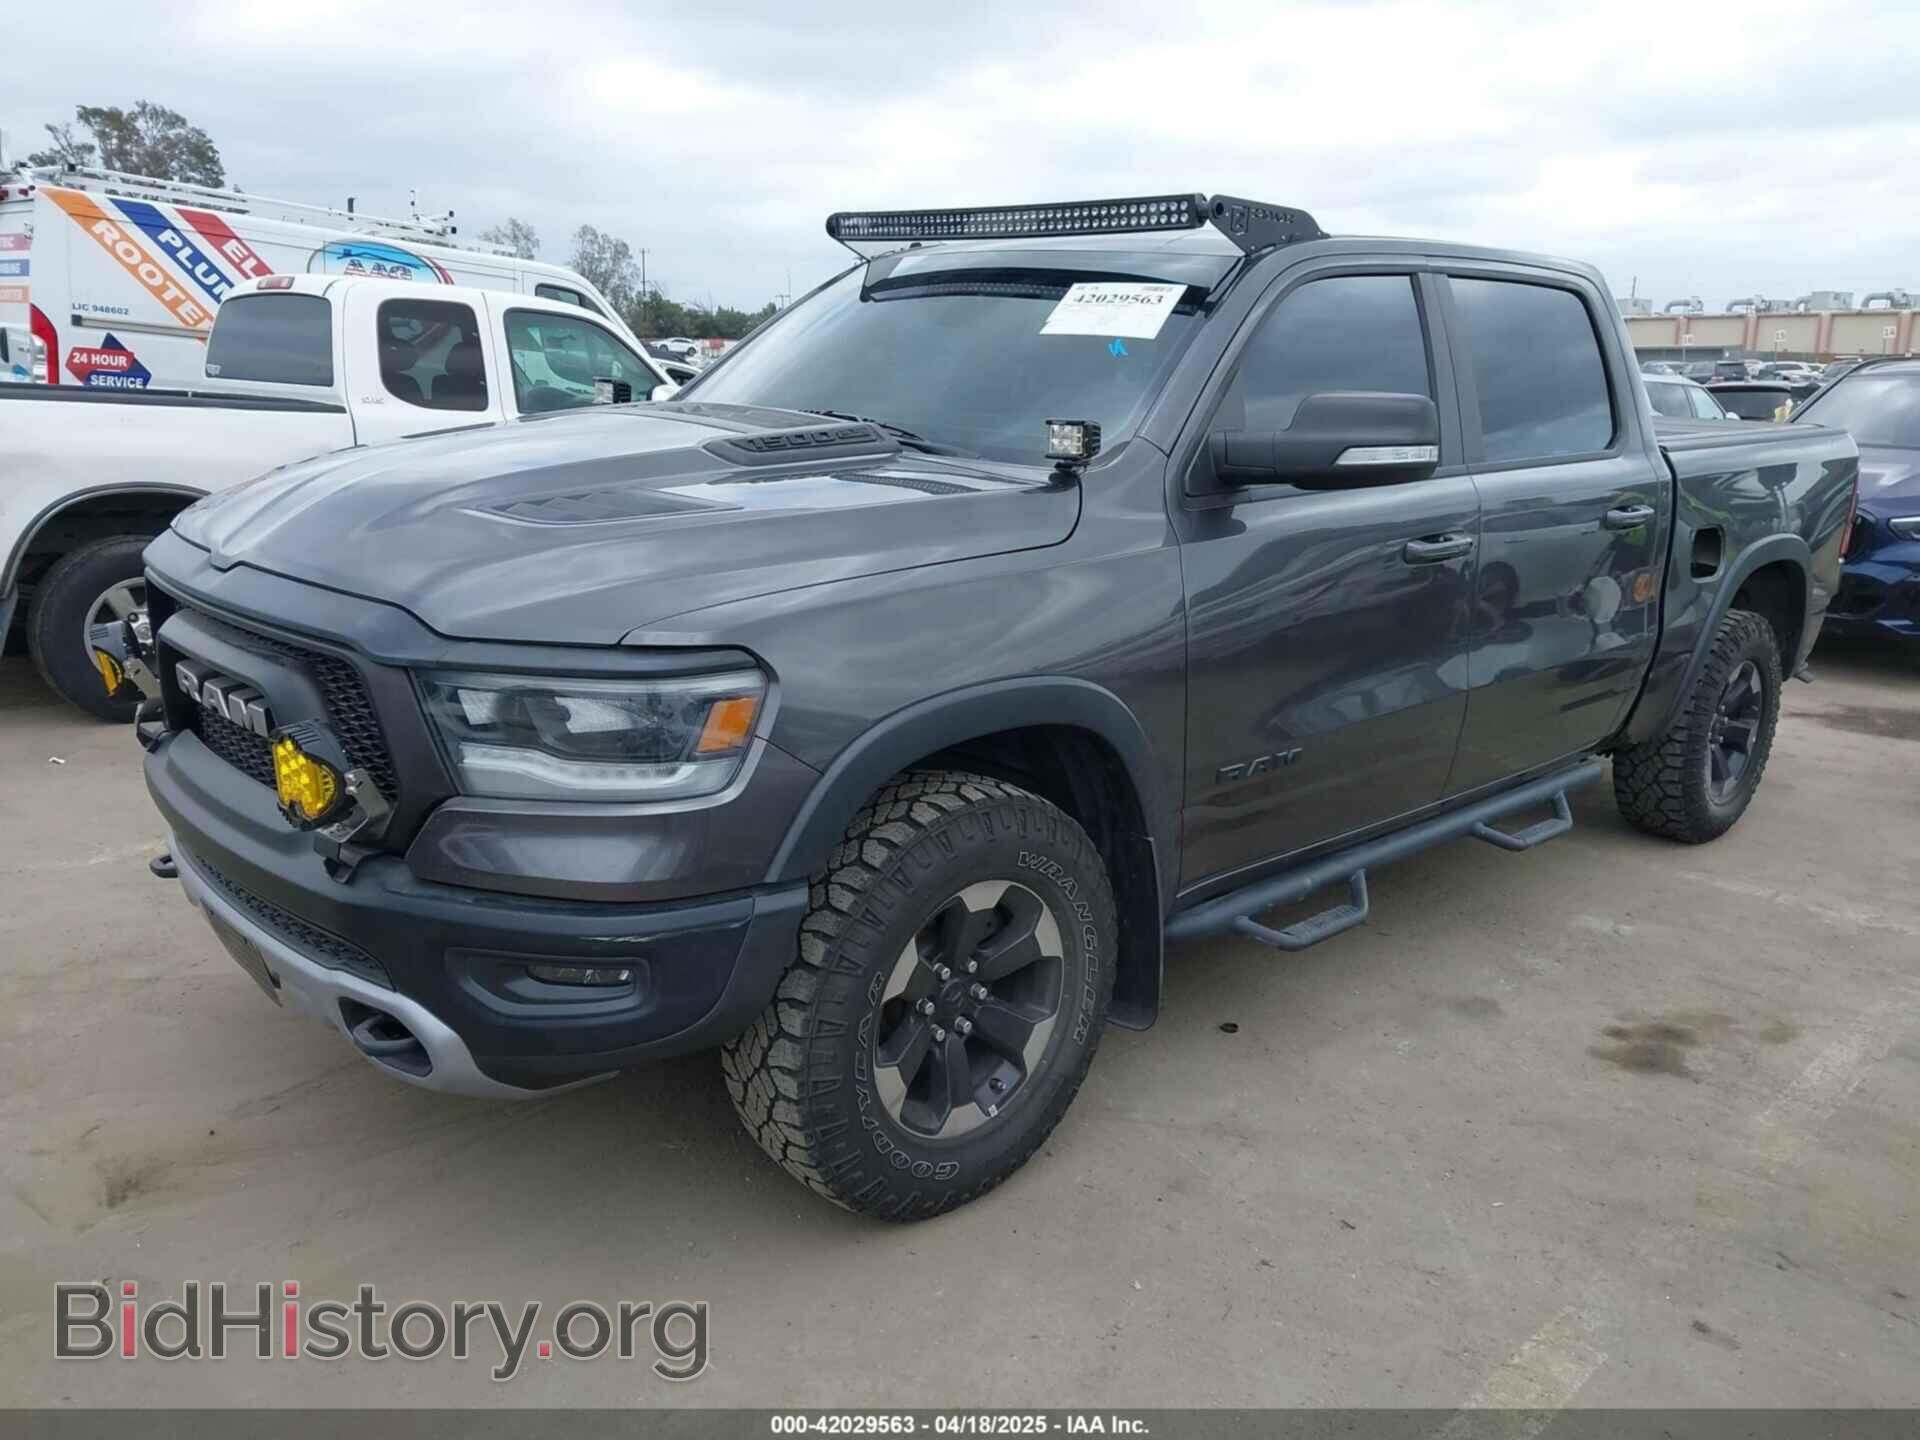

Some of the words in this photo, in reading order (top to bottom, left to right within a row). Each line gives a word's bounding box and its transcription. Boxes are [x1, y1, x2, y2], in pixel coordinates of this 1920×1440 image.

[1073, 293, 1164, 305] 42029563
[72, 303, 89, 311] LIC
[92, 304, 129, 315] 948602
[72, 352, 88, 364] 24
[91, 354, 128, 367] HOUR
[90, 374, 145, 389] SERVICE
[175, 663, 268, 738] RAM
[1216, 747, 1303, 784] RAM
